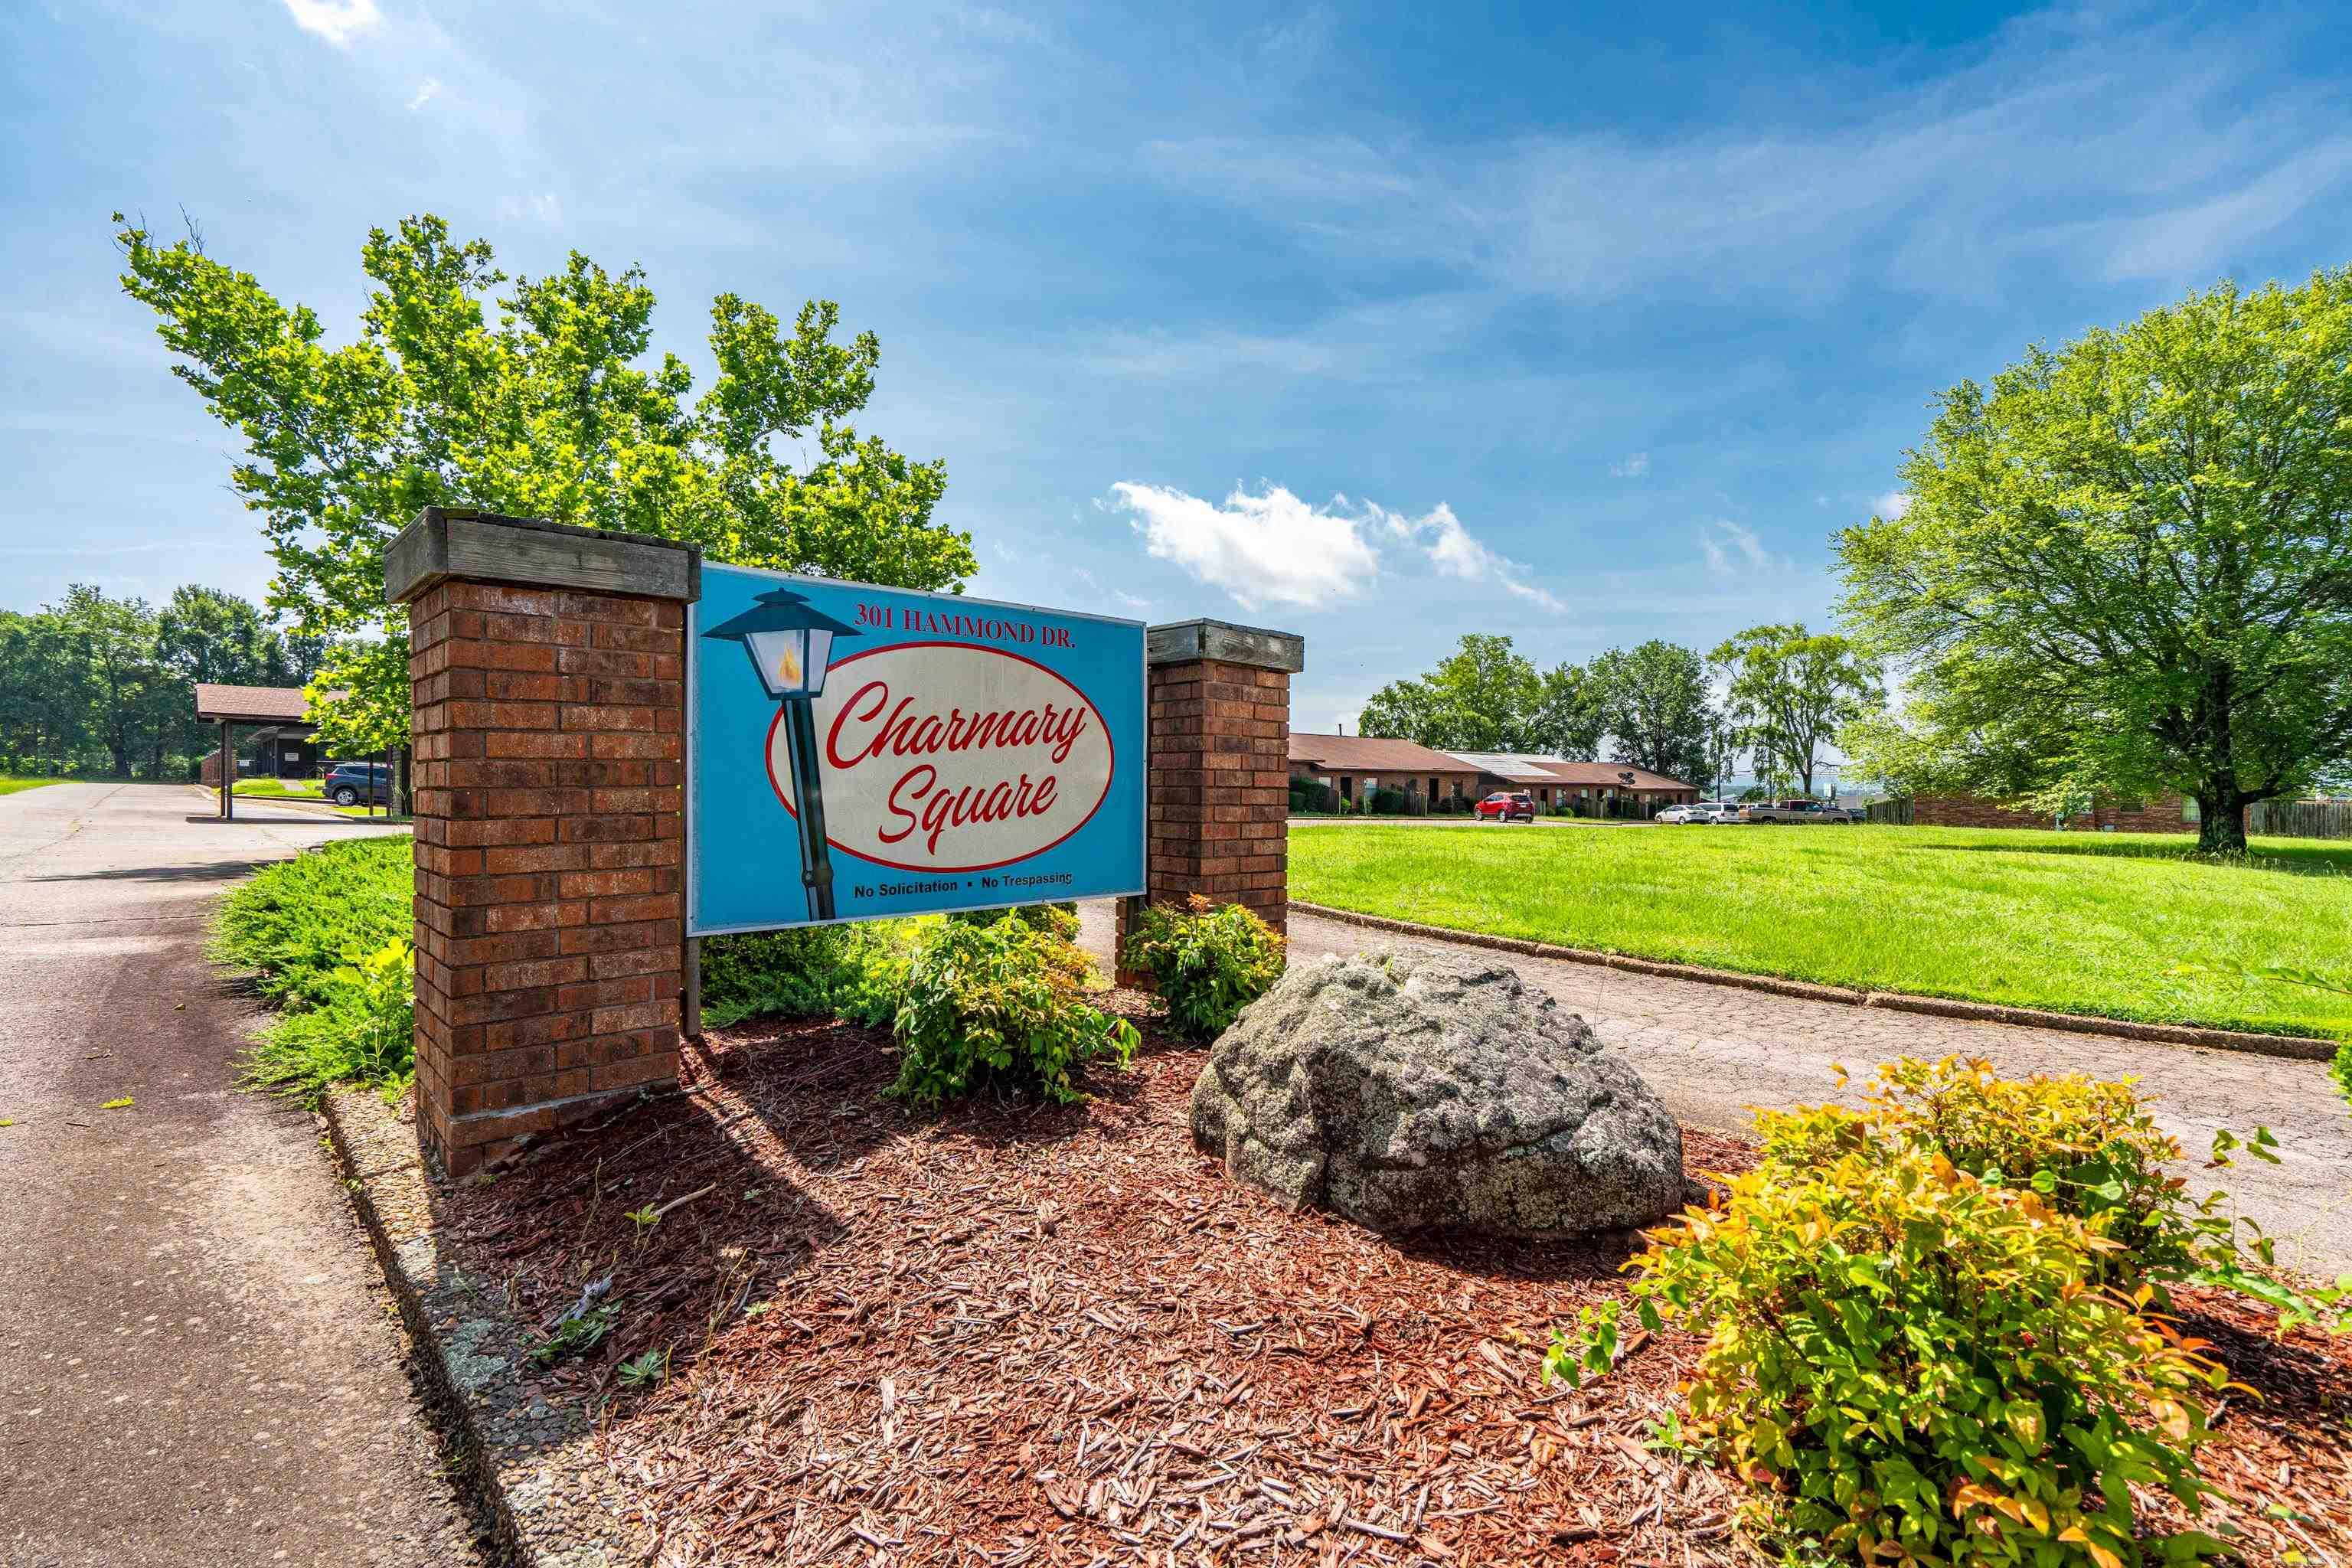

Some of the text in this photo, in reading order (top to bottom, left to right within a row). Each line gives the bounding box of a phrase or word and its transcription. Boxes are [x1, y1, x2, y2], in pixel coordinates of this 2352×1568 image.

[854, 603, 1076, 648] 301 HAMMOND DR.
[826, 681, 1086, 769] Charmary
[878, 764, 1058, 856] Square
[854, 872, 1072, 898] No Solicitation No Trespassing
